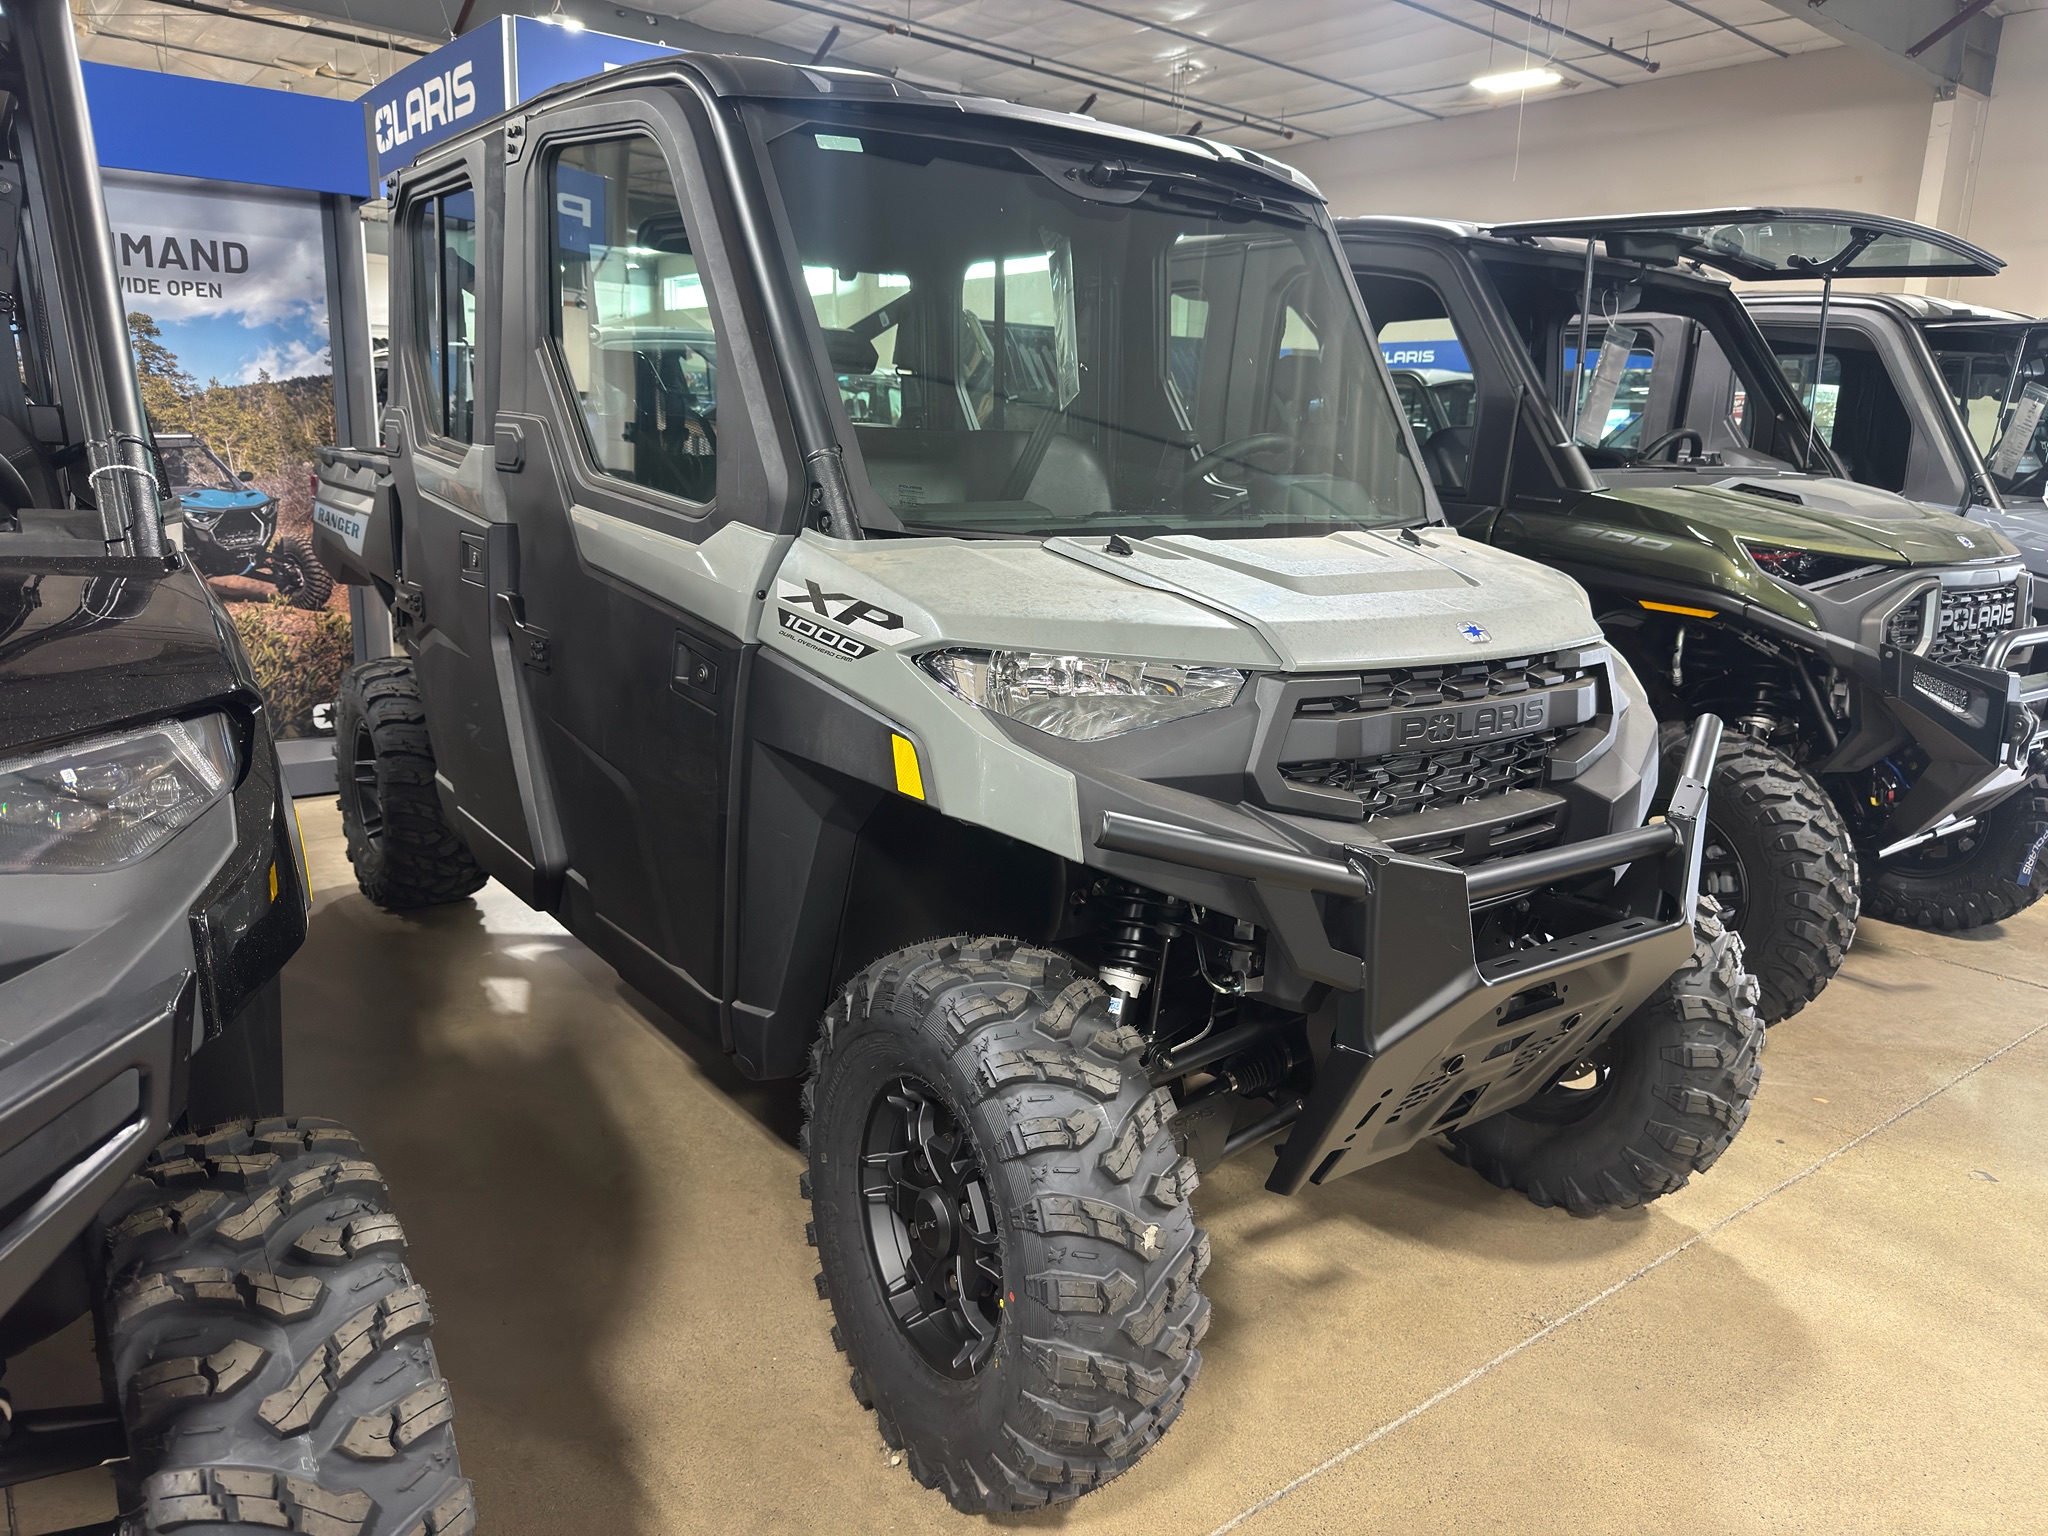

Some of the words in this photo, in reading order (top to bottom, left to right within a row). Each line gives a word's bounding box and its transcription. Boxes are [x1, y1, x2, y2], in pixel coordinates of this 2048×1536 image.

[111, 232, 249, 274] MAND
[167, 280, 222, 298] OPEN
[1382, 350, 1435, 364] LARIS
[318, 507, 360, 539] RANGER
[780, 578, 905, 630] XP
[1938, 602, 2015, 633] POLARIS
[779, 630, 796, 641] DUAL
[797, 639, 835, 658] OVERHEAD
[835, 653, 854, 663] CAM
[784, 614, 865, 657] 1000
[1400, 700, 1544, 747] POLARIS
